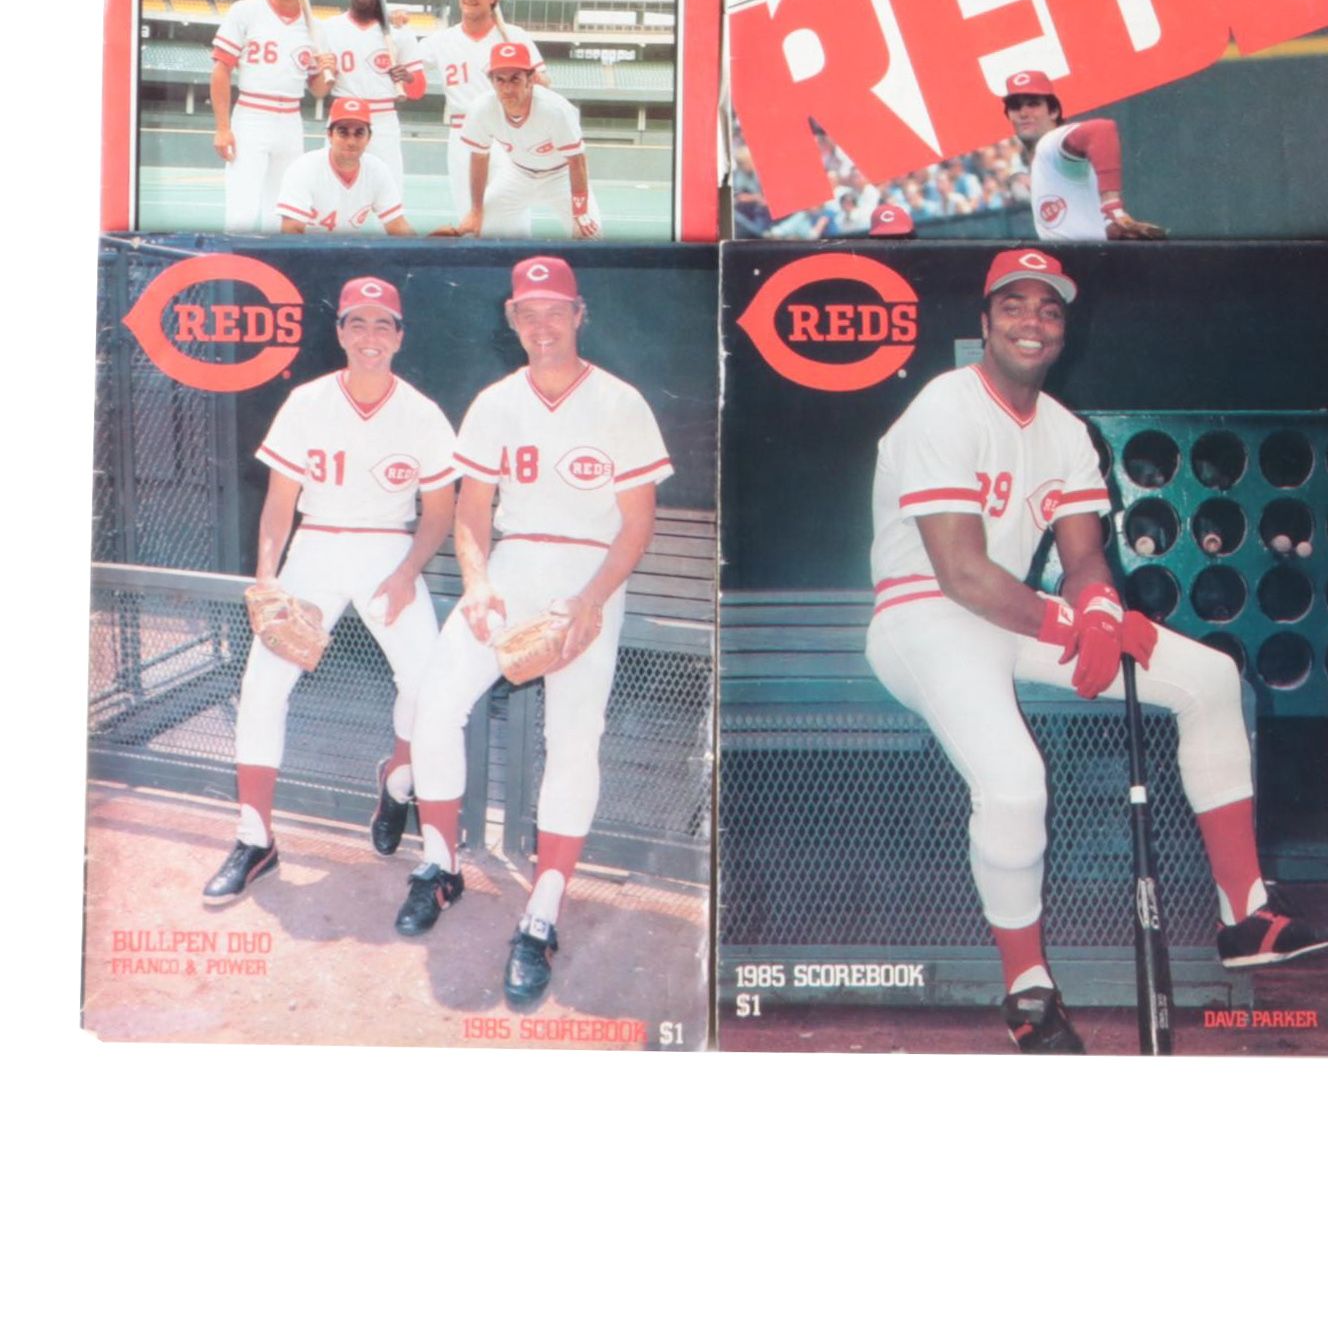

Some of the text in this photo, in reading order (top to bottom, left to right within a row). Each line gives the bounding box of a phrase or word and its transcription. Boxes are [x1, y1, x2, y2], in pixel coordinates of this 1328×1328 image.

[246, 41, 278, 64] 26
[445, 63, 469, 86] 21
[175, 305, 302, 343] REDS
[788, 304, 917, 342] REDS
[307, 449, 346, 486] 31
[572, 462, 615, 475] REDS
[112, 930, 216, 952] BULLPEN
[112, 959, 267, 975] FRANCO & POWER
[736, 965, 924, 989] 1985 SCOREBOOK
[736, 994, 761, 1017] $1
[1205, 1010, 1317, 1028] DAVE PARKER
[463, 1018, 683, 1045] 1985 SCOREBOOK $1
